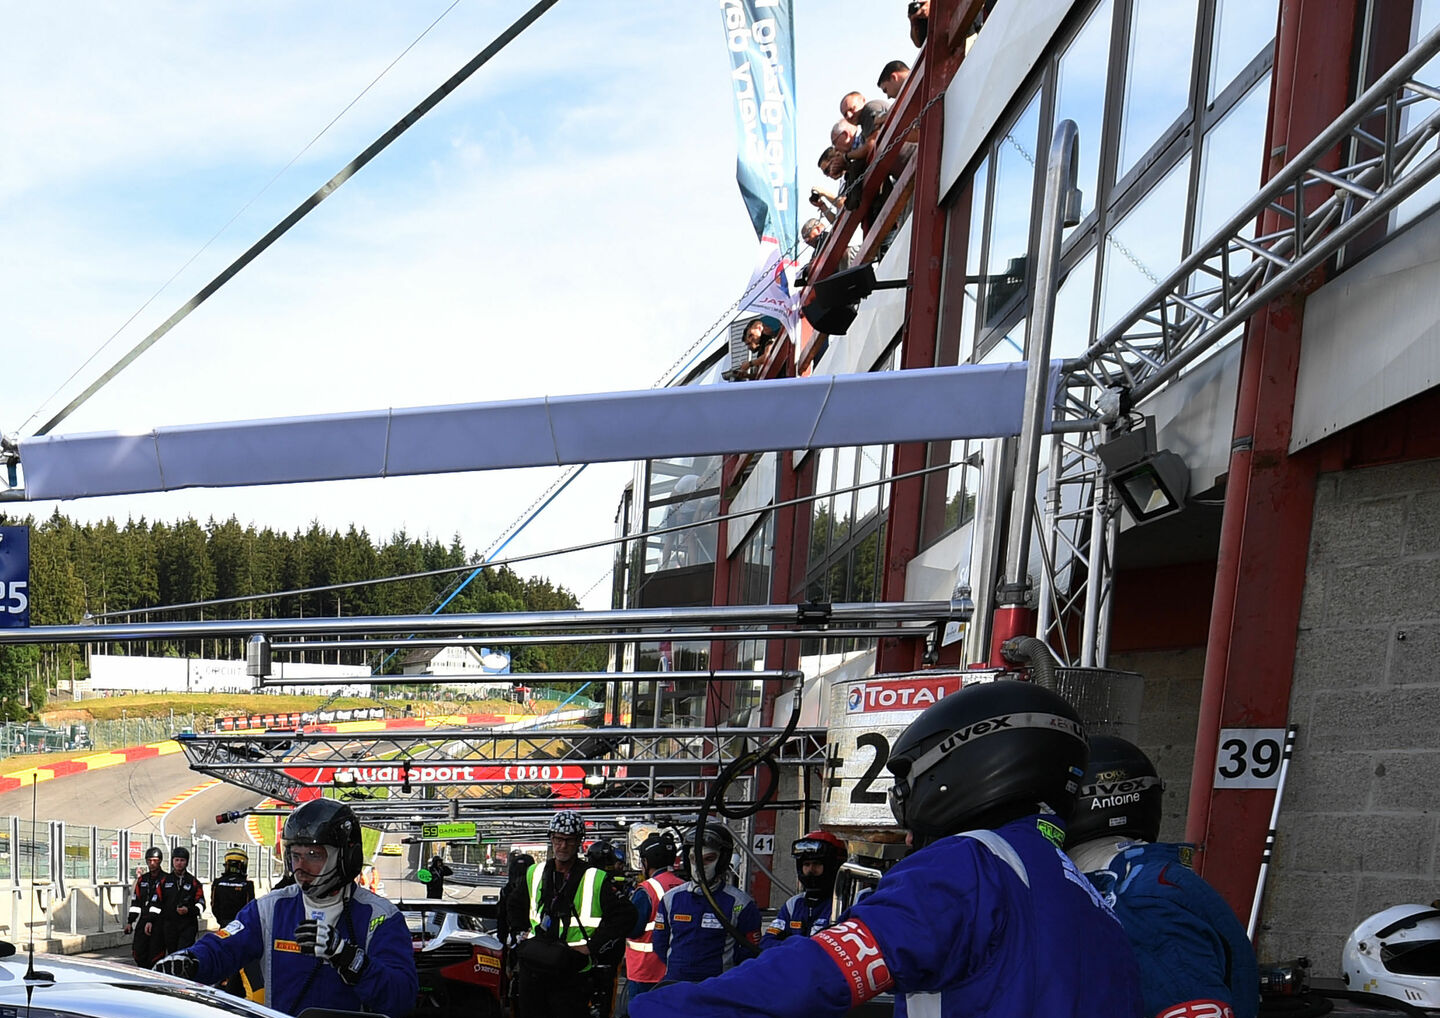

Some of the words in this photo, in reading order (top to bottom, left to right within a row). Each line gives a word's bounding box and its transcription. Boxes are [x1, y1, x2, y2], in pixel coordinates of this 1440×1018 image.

[939, 716, 1013, 754] uvex
[1218, 738, 1281, 779] 39
[407, 765, 474, 782] Sport
[1080, 778, 1146, 797] uvex
[1090, 791, 1141, 811] Antoine
[754, 837, 774, 851] 41
